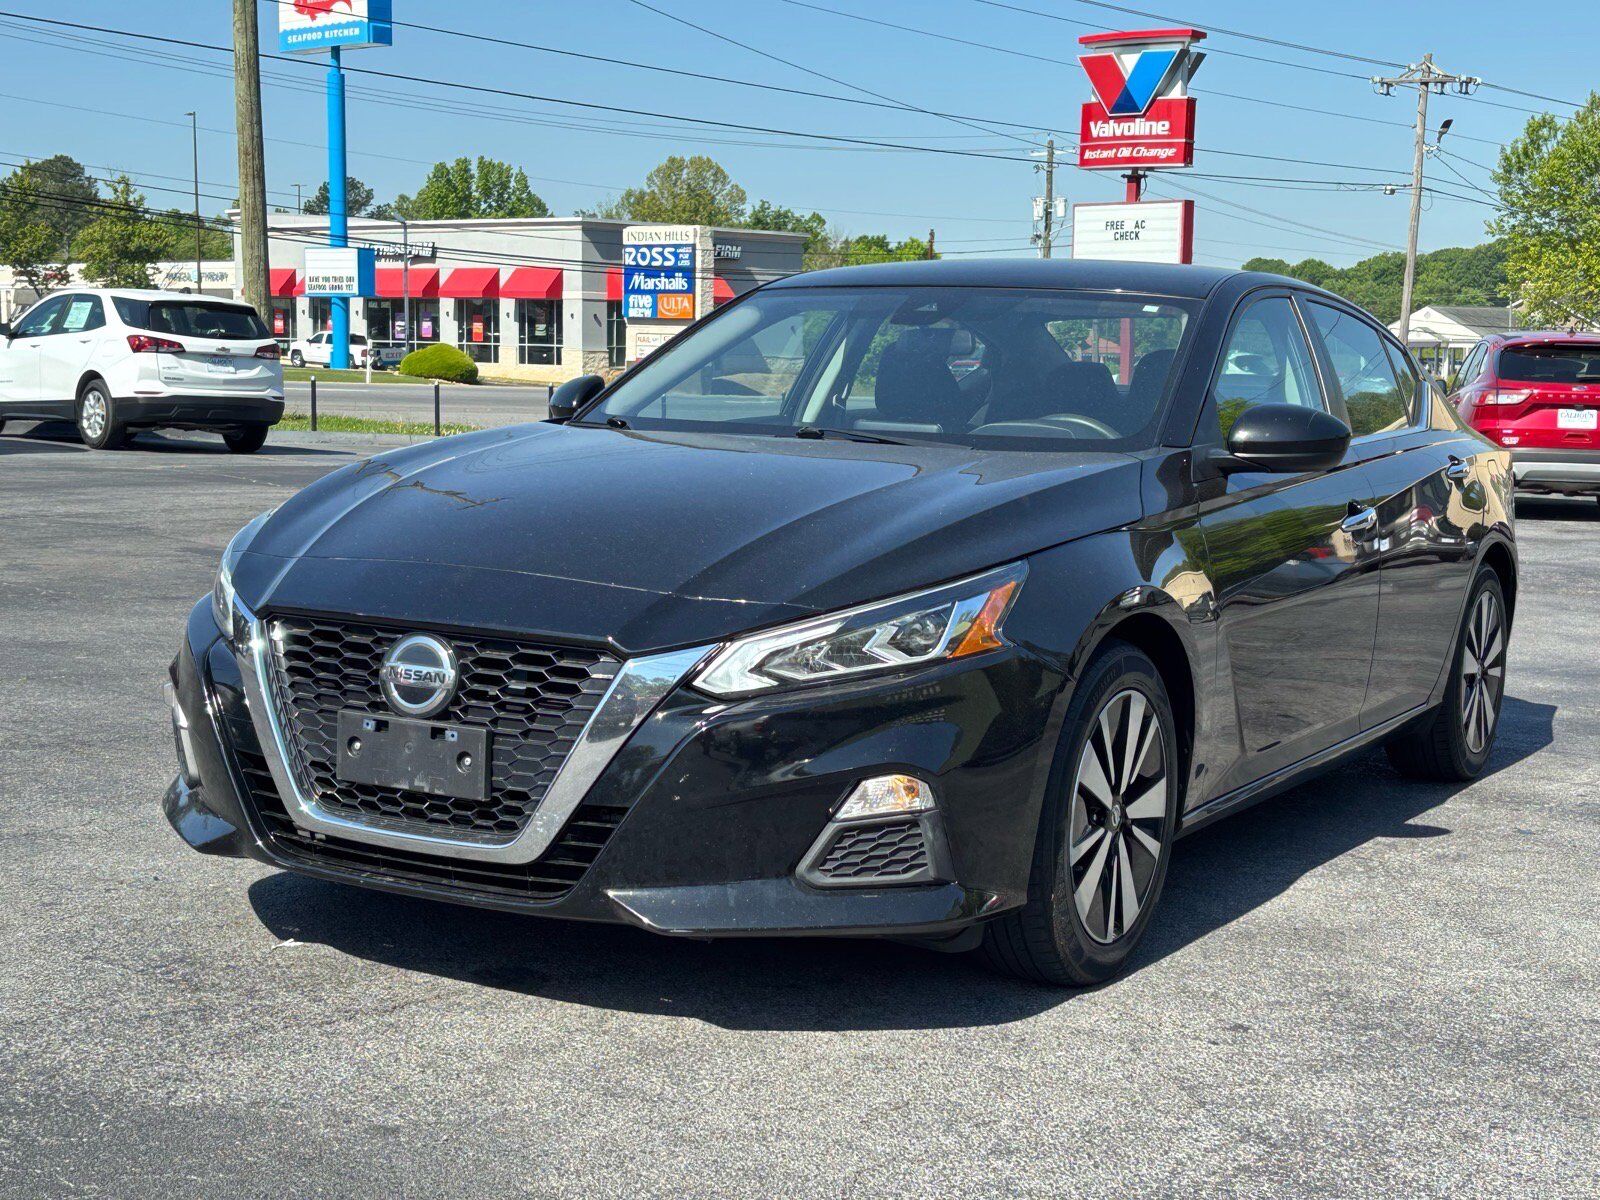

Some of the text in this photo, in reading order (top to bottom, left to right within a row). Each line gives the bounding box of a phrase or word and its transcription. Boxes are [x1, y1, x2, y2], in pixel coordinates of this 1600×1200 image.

[287, 27, 360, 43] SEAFOOD KITCHEN
[1089, 118, 1171, 138] Valvoline
[1084, 146, 1177, 160] Instant Oil Change
[1105, 219, 1146, 230] FREE AC
[627, 230, 690, 242] INDIAN HILLS
[1113, 231, 1140, 241] CHECK
[624, 247, 675, 267] ROSS
[715, 244, 741, 258] FIRM
[628, 272, 688, 291] Marshalls
[628, 294, 653, 308] five
[663, 296, 690, 311] ULTA
[388, 665, 446, 684] NISSAN
